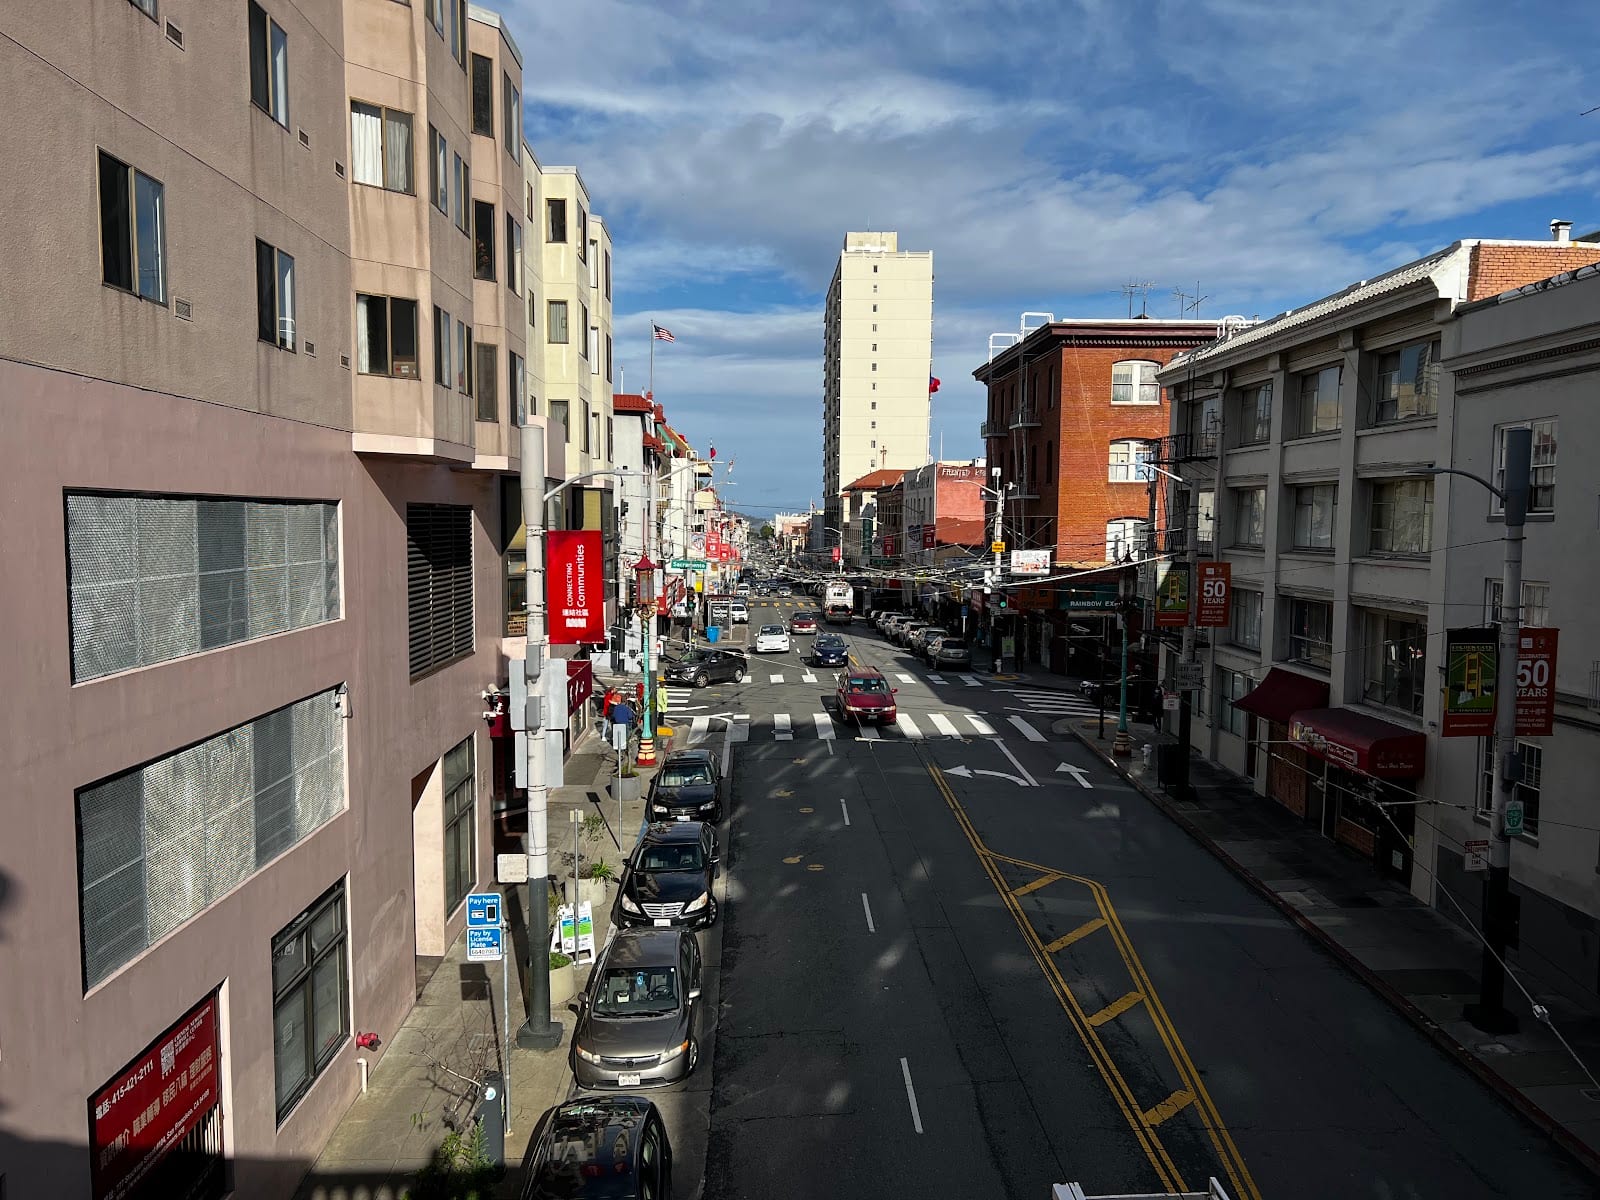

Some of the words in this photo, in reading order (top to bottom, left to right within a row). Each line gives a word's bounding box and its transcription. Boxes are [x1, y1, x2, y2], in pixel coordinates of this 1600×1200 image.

[576, 544, 585, 608] Communities
[1203, 581, 1225, 597] 50
[1516, 659, 1549, 687] 50
[1516, 688, 1548, 697] YEARS
[469, 897, 481, 905] Pay
[470, 930, 481, 938] Pay
[112, 1059, 154, 1104] 415-421-2111
